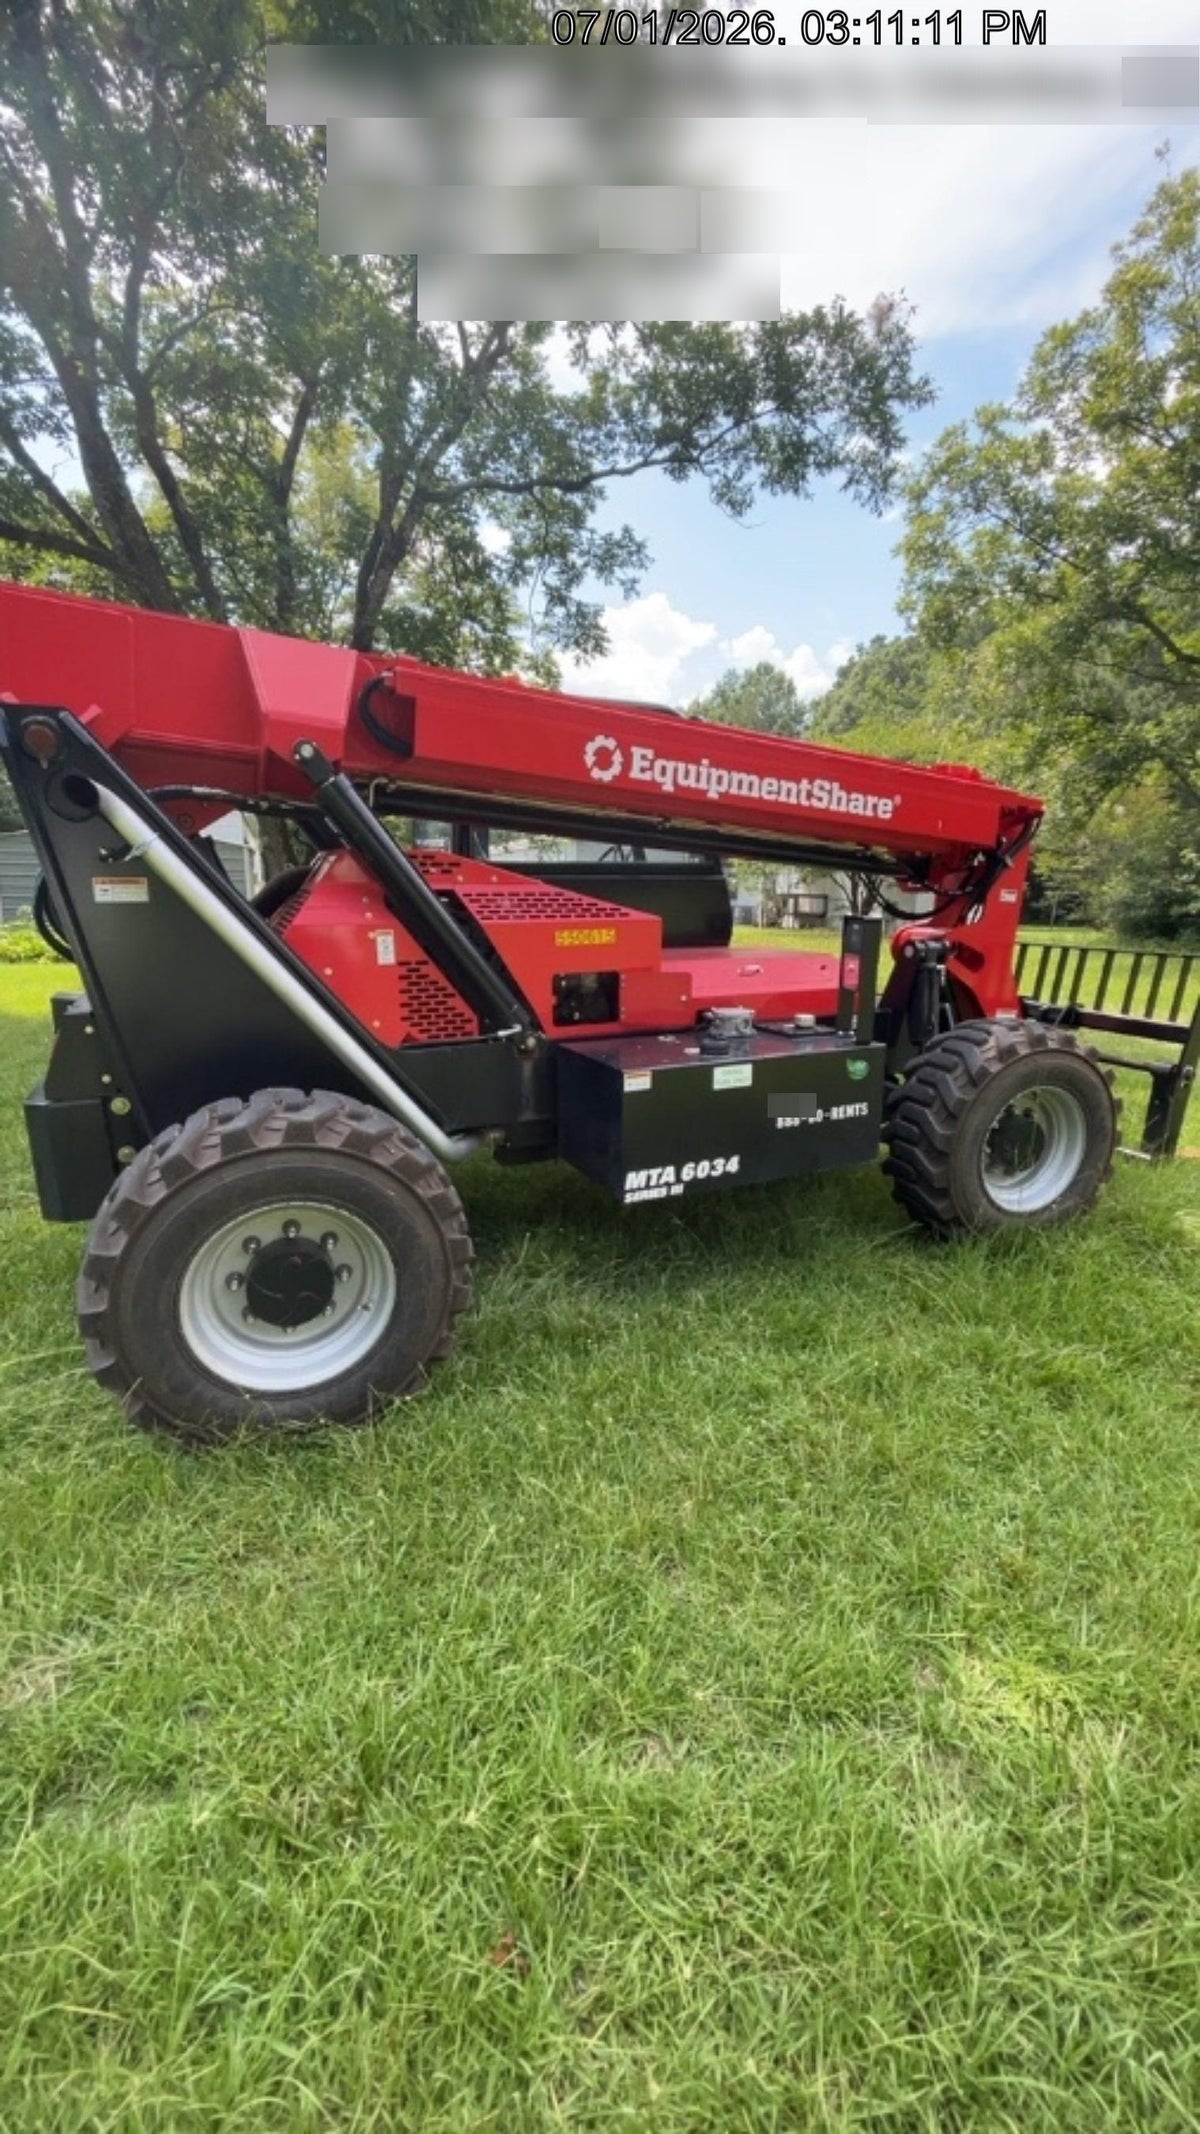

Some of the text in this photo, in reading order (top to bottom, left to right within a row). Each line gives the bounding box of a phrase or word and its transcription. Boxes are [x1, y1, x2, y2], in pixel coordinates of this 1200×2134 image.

[629, 745, 894, 820] EquipmentShare
[625, 1155, 740, 1191] MTA 6034
